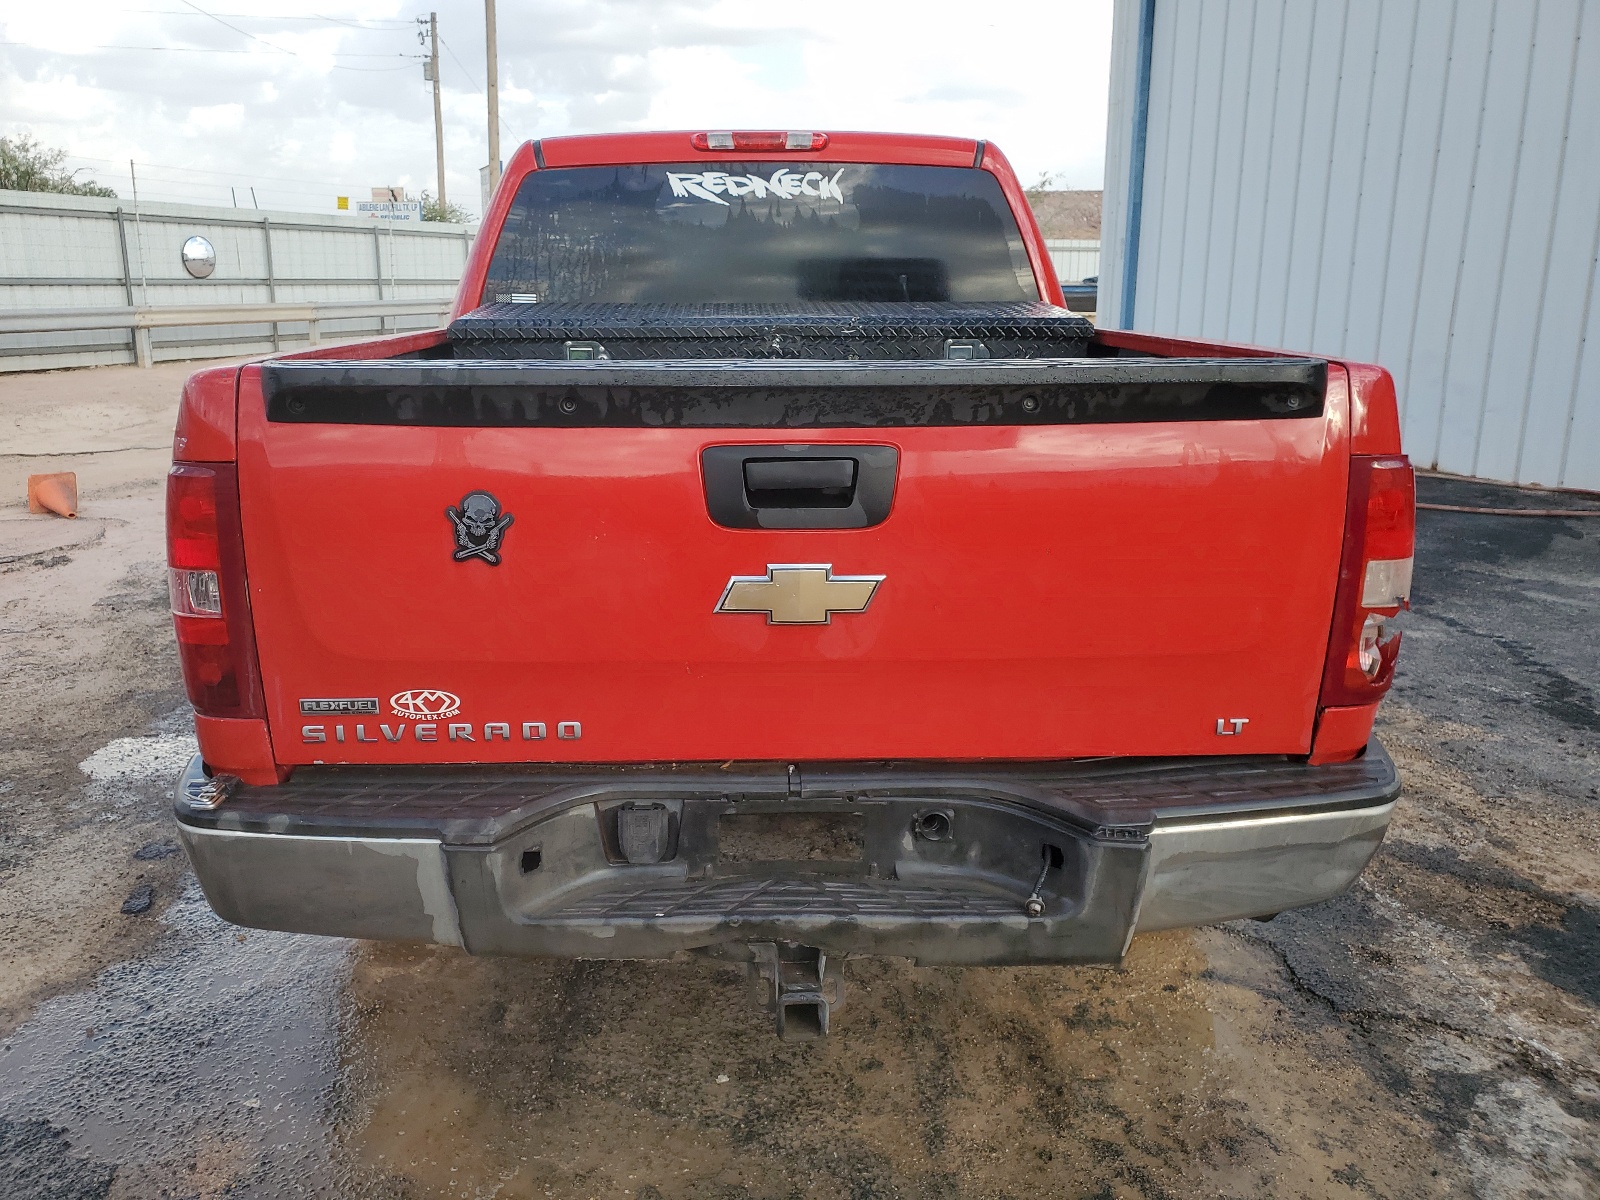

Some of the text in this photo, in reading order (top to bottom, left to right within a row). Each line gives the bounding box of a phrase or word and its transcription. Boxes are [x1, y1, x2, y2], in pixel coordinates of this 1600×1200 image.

[665, 167, 845, 206] REDNECK
[359, 203, 379, 211] ABILENE
[303, 701, 376, 711] FLEXFUEL
[390, 708, 461, 721] AUTOPLEX.COM
[301, 722, 581, 742] SILVERADO
[1216, 718, 1250, 736] LT
